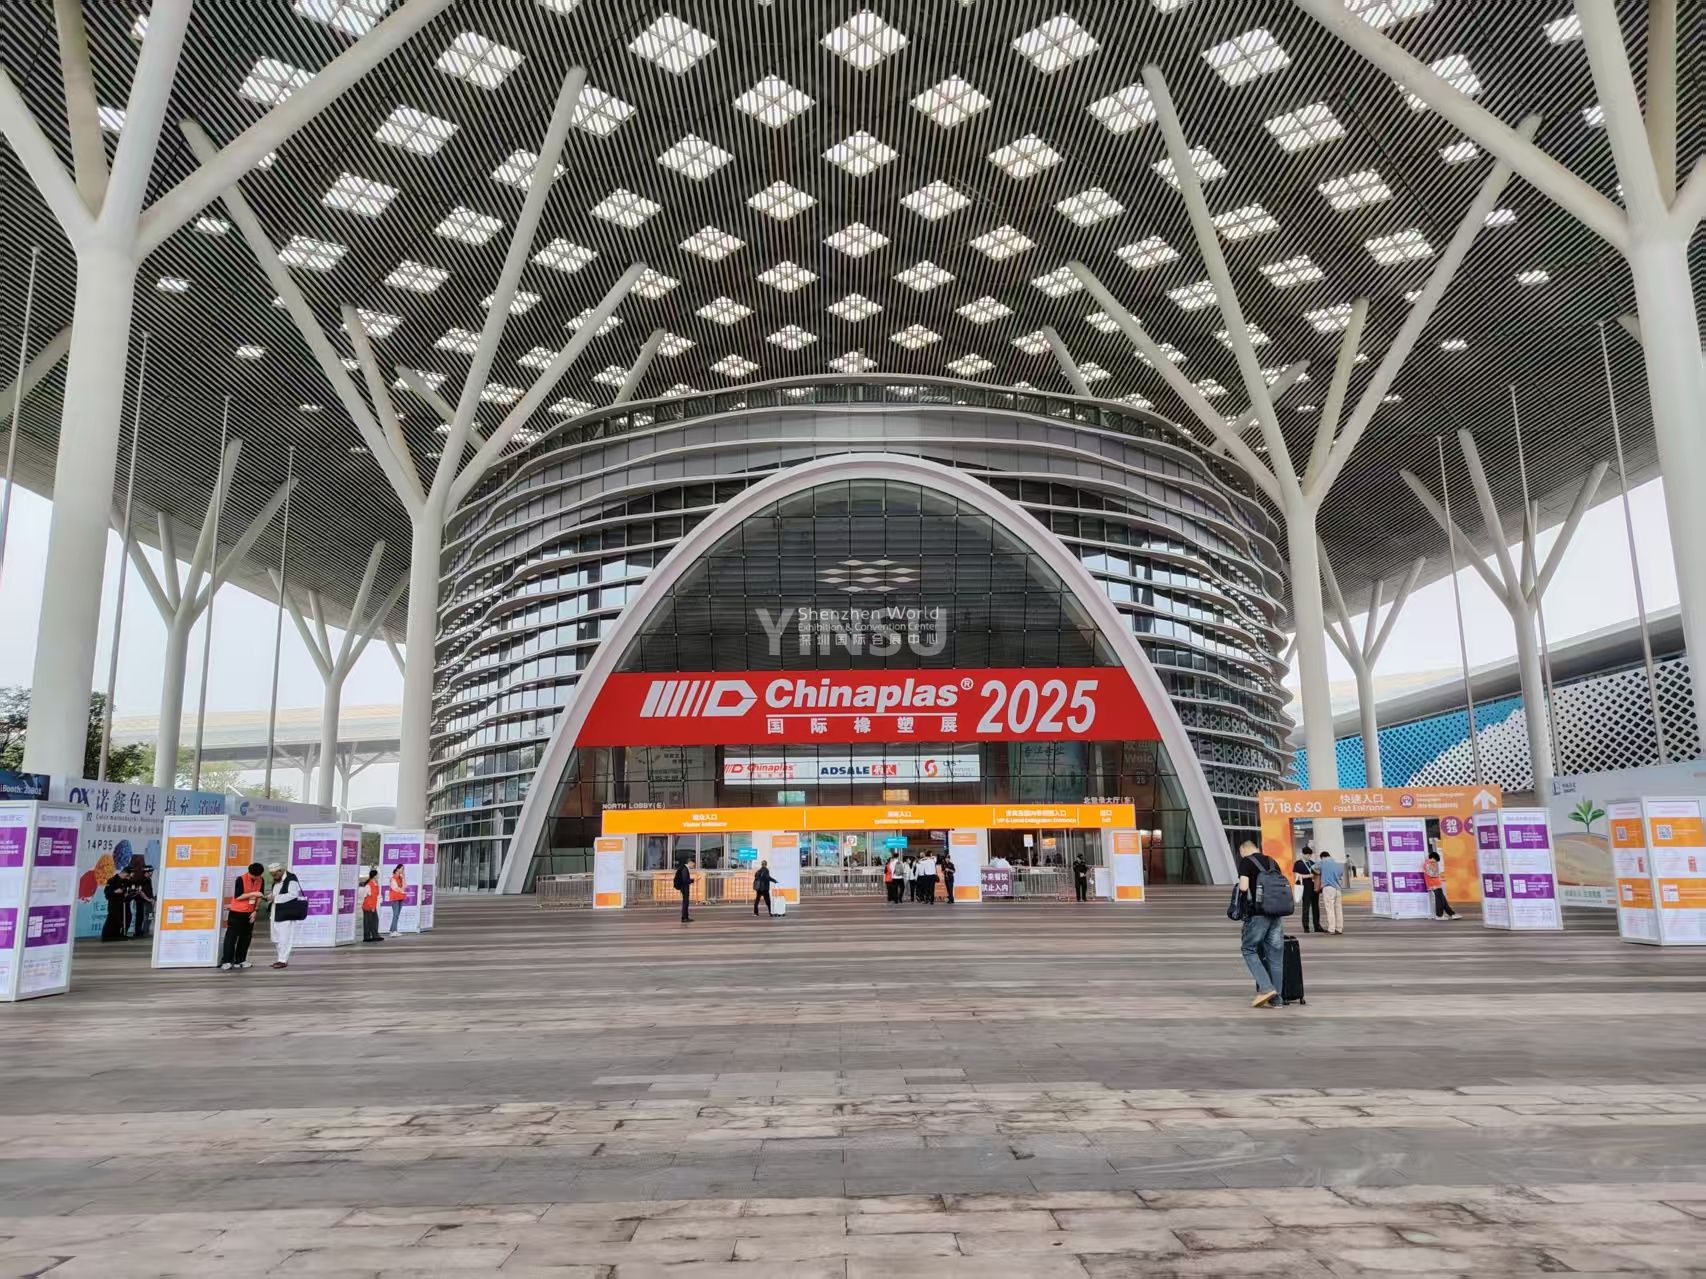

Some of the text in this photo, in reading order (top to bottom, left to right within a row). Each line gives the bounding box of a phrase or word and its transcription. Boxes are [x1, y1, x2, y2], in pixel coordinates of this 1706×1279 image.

[798, 606, 939, 621] Shenzhen World
[798, 622, 843, 632] Exhibition
[854, 622, 907, 632] Convention
[908, 622, 938, 632] Center
[799, 633, 938, 646] 深圳国际会展中心
[976, 679, 1098, 733] 2025
[767, 716, 958, 734] 国际橡塑展
[747, 763, 794, 774] Chinapls
[821, 767, 870, 775] ADSALE
[1264, 801, 1322, 814] 17, 18 & 20
[87, 839, 113, 850] 14P35
